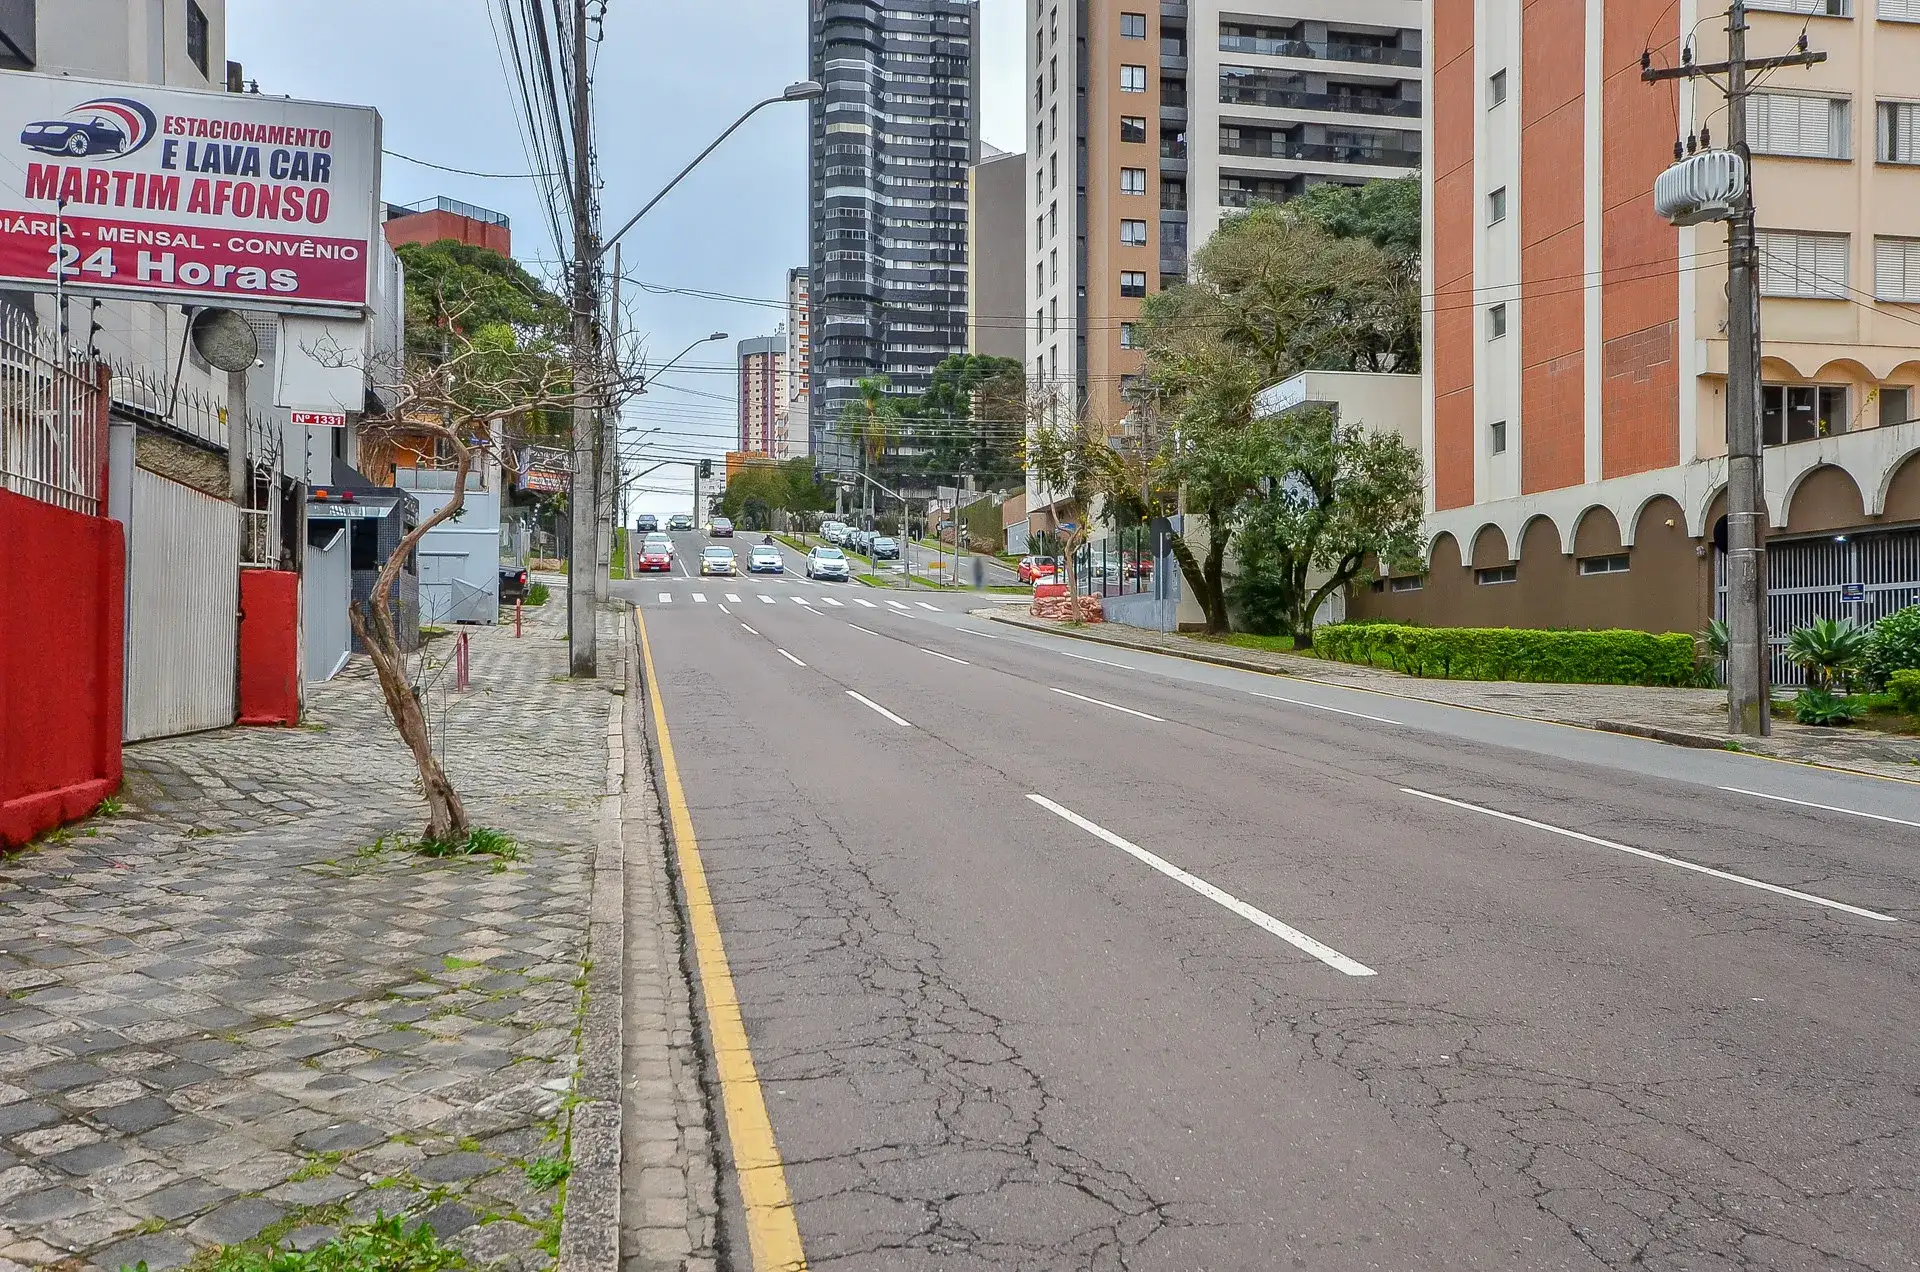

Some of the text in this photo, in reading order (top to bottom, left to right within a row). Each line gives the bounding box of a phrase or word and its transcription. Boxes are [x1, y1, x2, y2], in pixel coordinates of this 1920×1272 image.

[163, 115, 332, 149] ESTACIONAMENTO
[161, 139, 332, 184] E LAVA CAR
[25, 162, 330, 224] MARTIM AFONSO
[0, 215, 75, 239] IÁRIA
[98, 226, 205, 250] MENSAL
[227, 239, 359, 261] CONVÊNIO
[47, 243, 299, 293] 24 Horas
[313, 415, 342, 425] 1331
